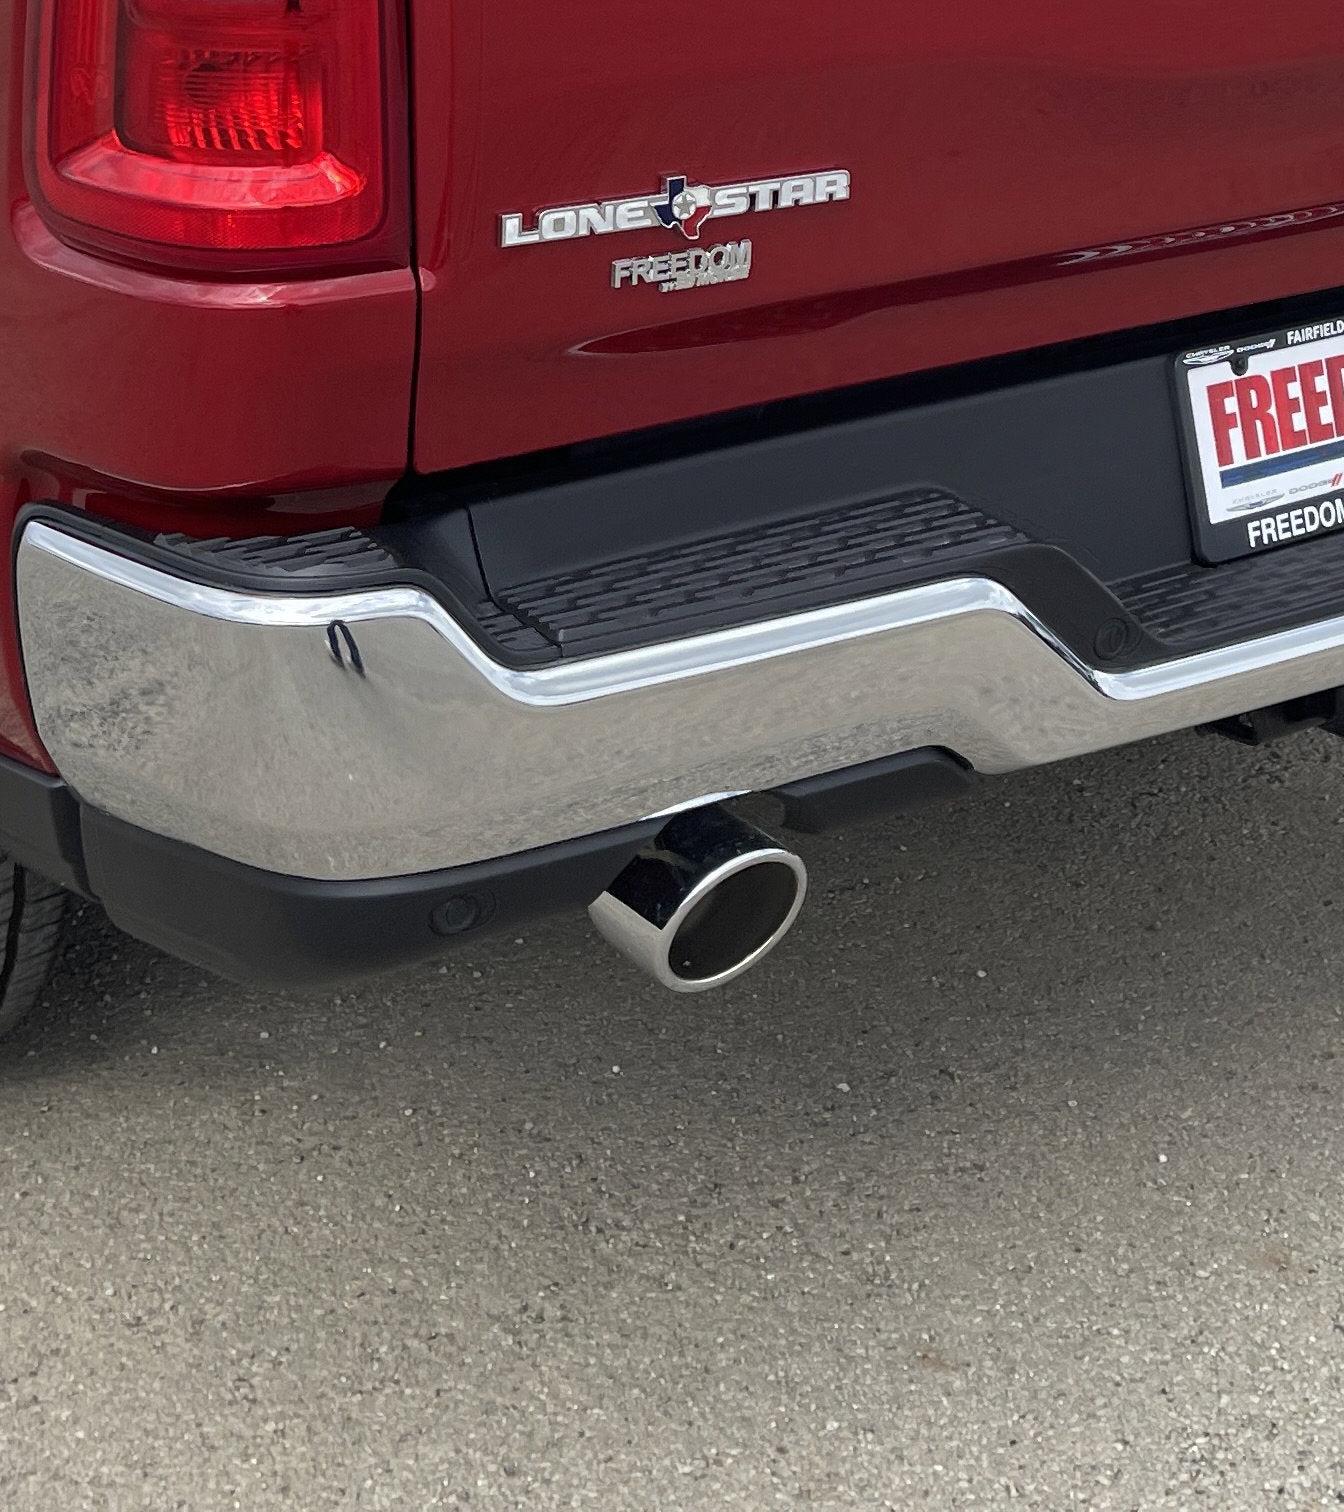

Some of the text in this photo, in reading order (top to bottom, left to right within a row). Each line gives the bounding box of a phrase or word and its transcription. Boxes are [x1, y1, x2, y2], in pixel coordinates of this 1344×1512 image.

[501, 170, 851, 248] LONE STAR
[612, 239, 752, 289] FREEDOM
